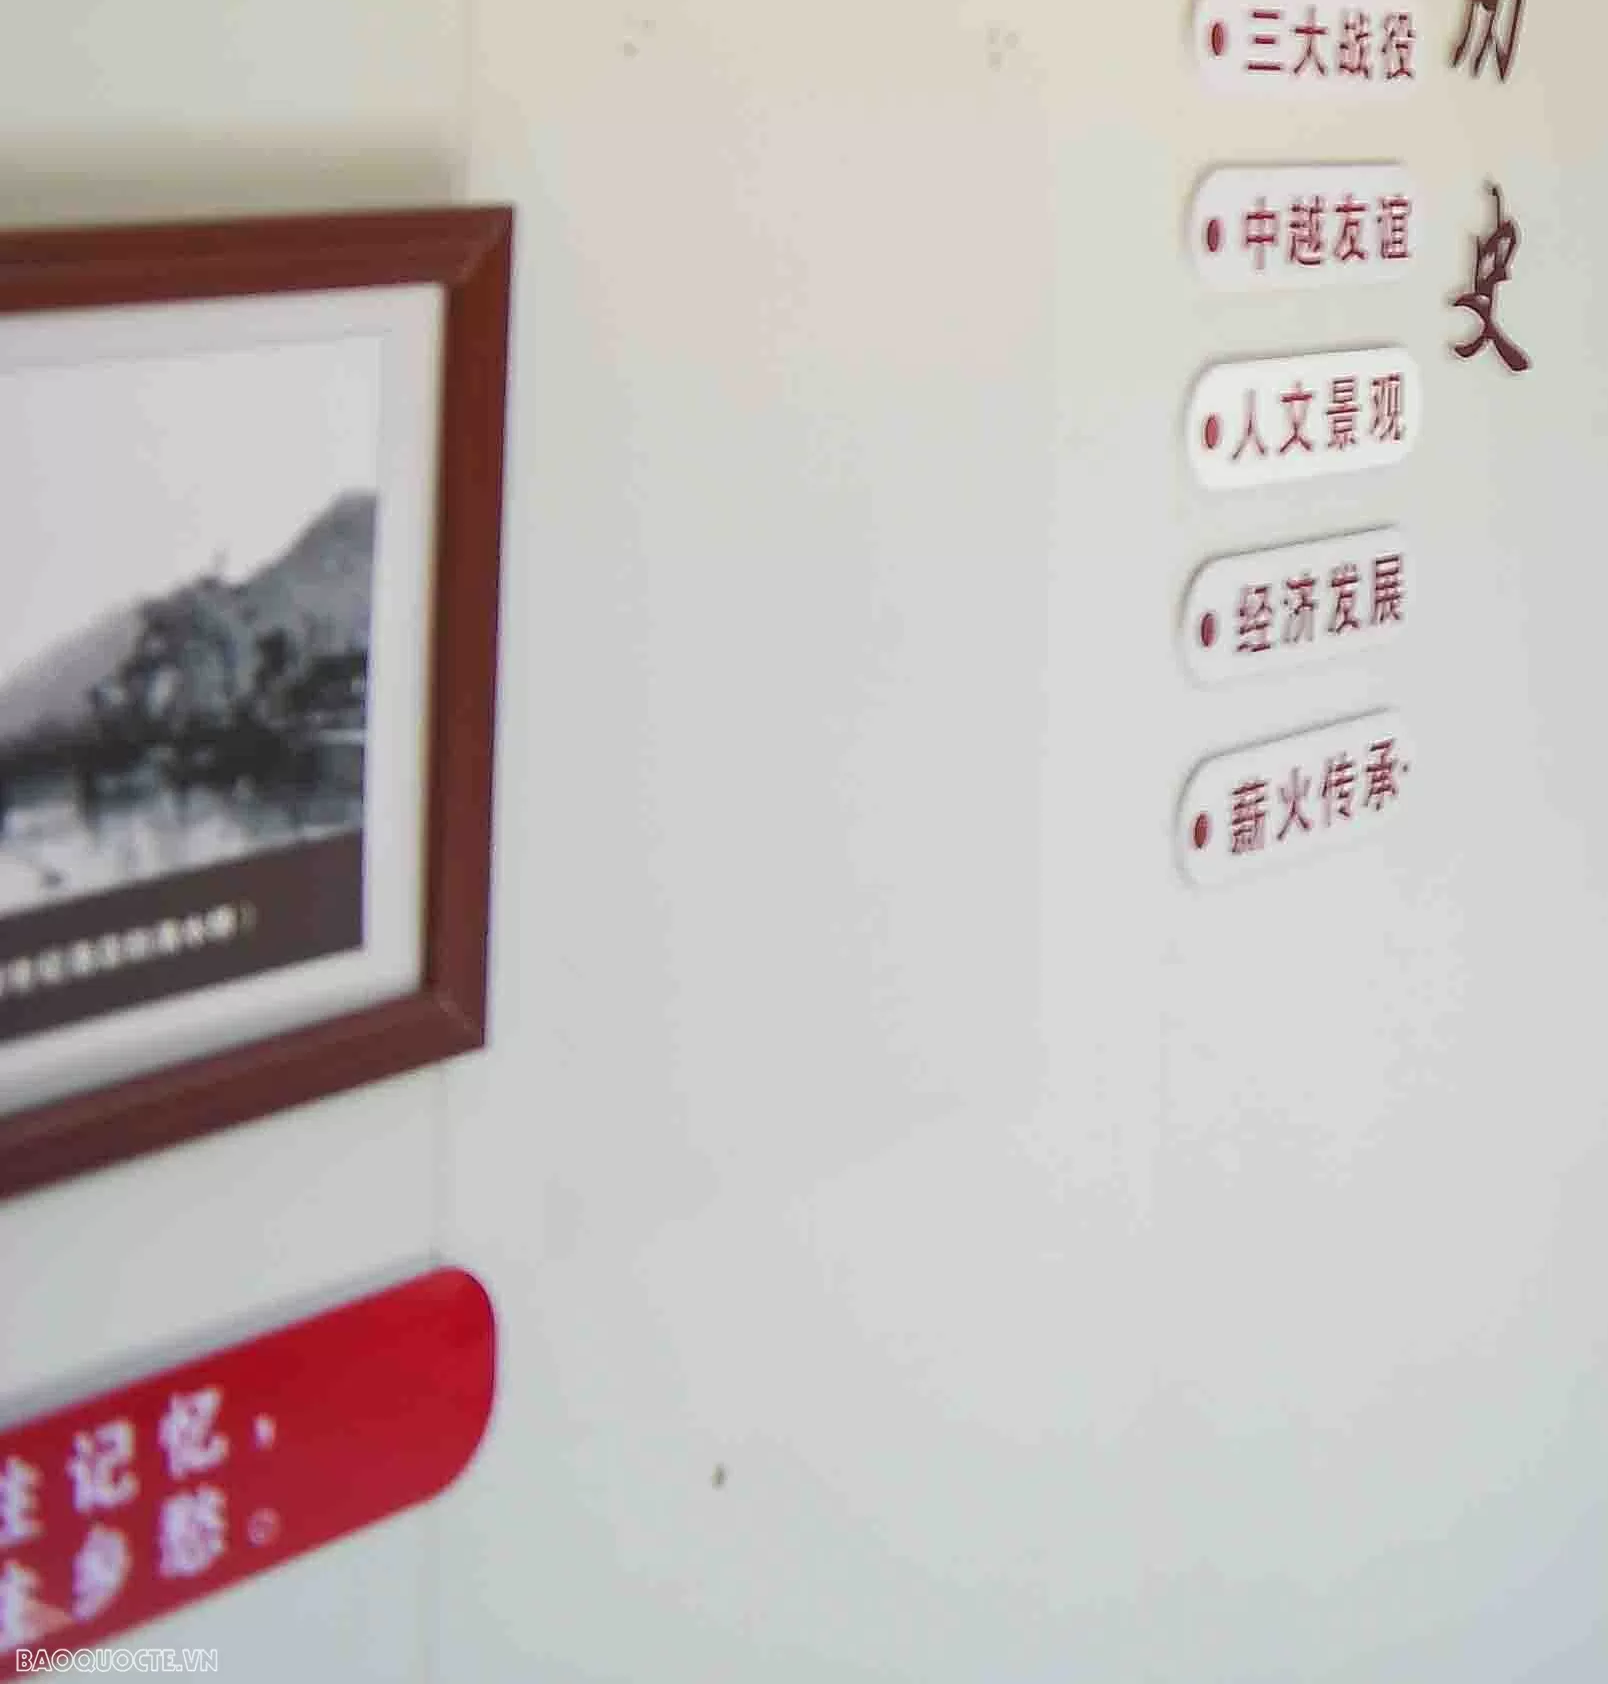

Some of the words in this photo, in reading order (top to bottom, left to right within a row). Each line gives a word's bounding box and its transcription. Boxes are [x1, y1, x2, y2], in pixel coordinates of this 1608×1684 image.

[1246, 6, 1418, 82] 三大战役
[1241, 193, 1412, 271] 中越友谊
[1231, 371, 1408, 463] 人文景观
[1234, 553, 1407, 654] 经济发展
[1227, 737, 1401, 856] 薪火传承
